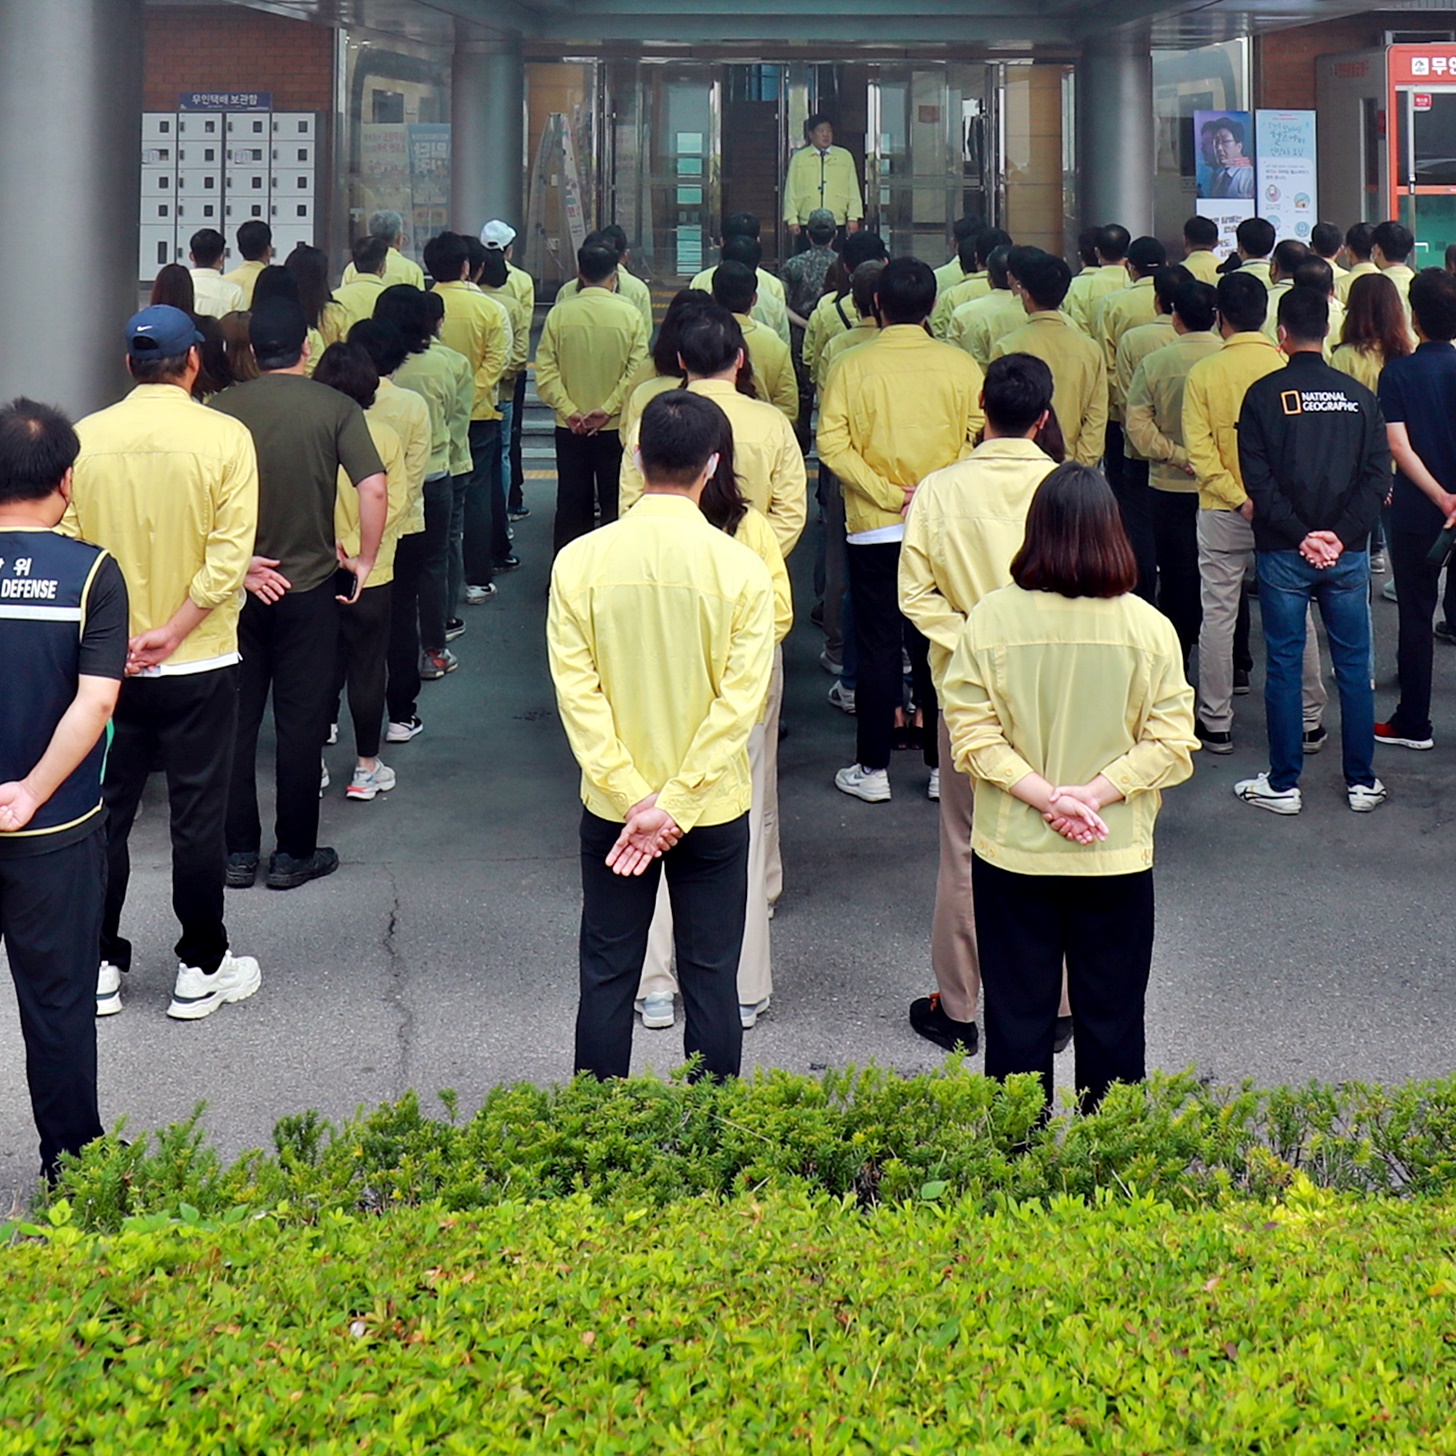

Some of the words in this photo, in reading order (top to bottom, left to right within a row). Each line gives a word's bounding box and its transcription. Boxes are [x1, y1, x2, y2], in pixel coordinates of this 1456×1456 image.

[1301, 392, 1347, 401] NATIONAL
[1302, 401, 1359, 413] GEOGRAPHIC
[0, 579, 58, 598] DEFENSE
